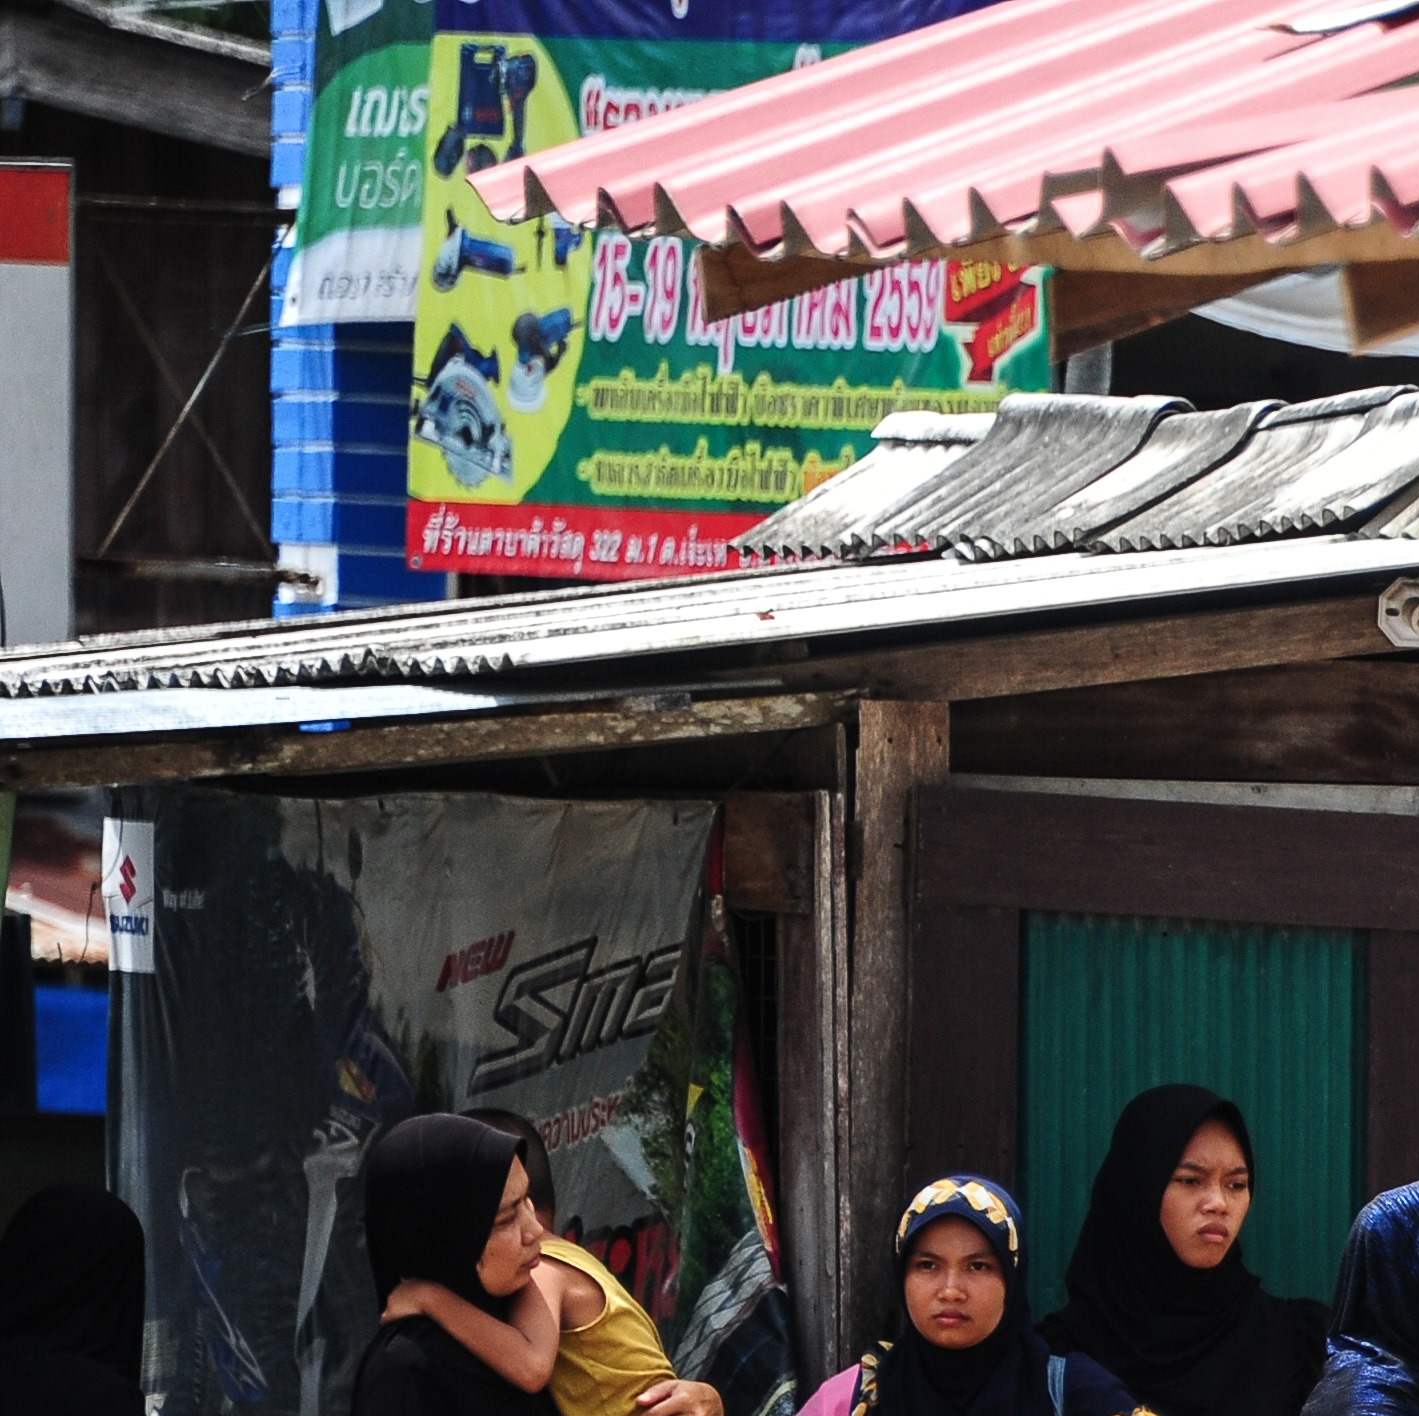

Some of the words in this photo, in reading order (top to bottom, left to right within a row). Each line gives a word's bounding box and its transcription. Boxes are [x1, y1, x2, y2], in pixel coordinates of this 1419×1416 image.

[590, 236, 682, 342] 15-19
[864, 258, 941, 351] 2559
[110, 914, 148, 936] SUZUKI
[435, 930, 516, 992] NEW
